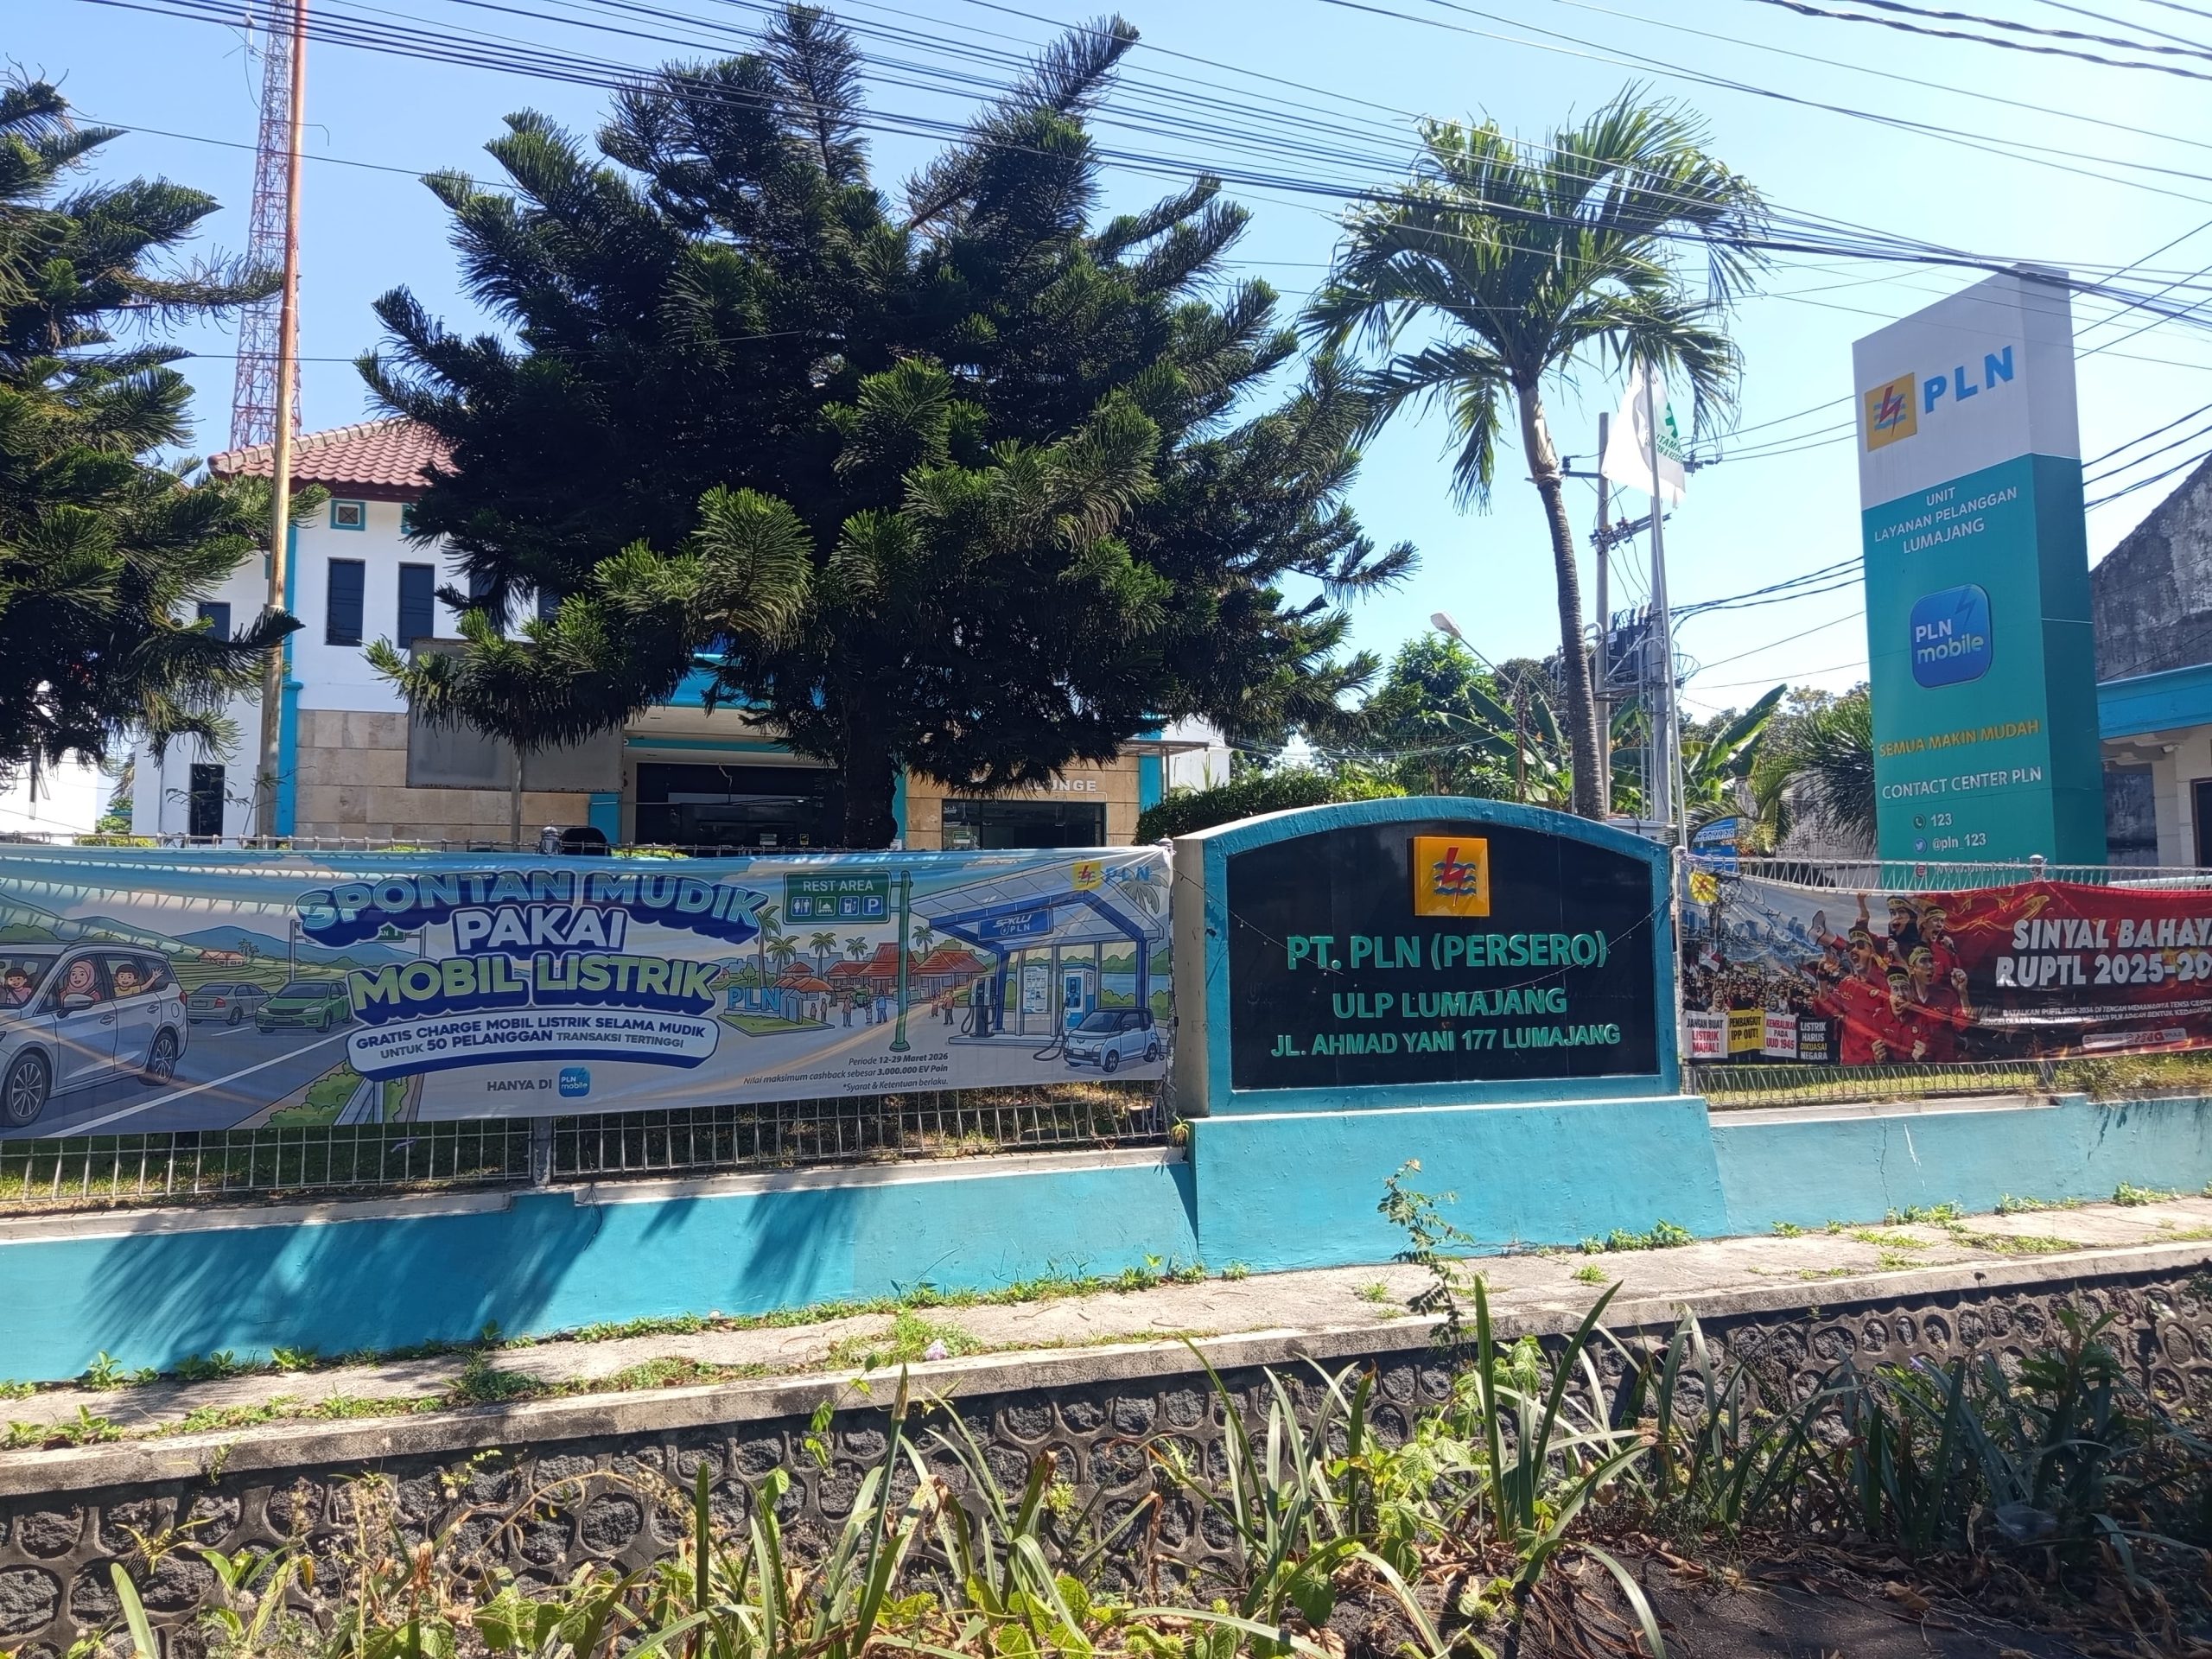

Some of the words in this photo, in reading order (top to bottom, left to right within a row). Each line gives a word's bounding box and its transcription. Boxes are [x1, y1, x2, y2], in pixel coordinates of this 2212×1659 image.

[1923, 345, 2014, 415] PLN
[1926, 486, 1956, 507] UNIT
[1874, 514, 1933, 543] LAYANAN
[1935, 486, 2018, 524] PELANGGAN
[1903, 517, 1985, 554] LUMAJANG
[1915, 618, 1953, 643] PLN
[1916, 632, 1985, 664] mobile
[1878, 739, 1926, 758] SEMUA
[1928, 729, 1977, 750] MAKIN
[1980, 719, 2040, 741] MUDAH
[1882, 779, 1948, 799] CONTACT
[1951, 771, 2008, 791] CENTER
[2012, 766, 2043, 783] PLN
[1930, 813, 1953, 827] 123
[1932, 832, 1986, 851] @pln_123
[803, 880, 836, 893] REST
[839, 880, 874, 892] AREA
[297, 872, 570, 931] SPONTAN
[589, 873, 769, 928] MUDIK
[868, 899, 879, 913] P
[455, 907, 625, 950] PAKAI
[1010, 923, 1031, 933] PLN
[2012, 918, 2109, 949] SINYAL
[2117, 918, 2212, 947] BAHAY
[1286, 935, 1342, 970] PT.
[1350, 935, 1421, 969] PLN
[1431, 930, 1608, 971] (PERSERO)
[1995, 955, 2086, 987] RUPTL
[348, 956, 524, 1011] MOBIL
[537, 954, 721, 1001] LISTRIK
[728, 987, 779, 1012] PLN
[1332, 992, 1395, 1019] ULP
[1401, 987, 1567, 1018] LUMAJANG
[1687, 1018, 1707, 1028] JANGAN
[1708, 1019, 1724, 1028] BUAT
[1729, 1016, 1761, 1028] PEMBANGKIT
[1800, 1021, 1827, 1032] LISTRIK
[356, 1029, 412, 1050] GRATIS
[416, 1020, 481, 1039] CHARGE
[486, 1017, 534, 1031] MOBIL
[537, 1017, 591, 1028] LISTRIK
[595, 1018, 655, 1032] SELAMA
[658, 1021, 706, 1038] MUDIK
[1270, 1033, 1307, 1058] JL.
[1311, 1033, 1398, 1056] AHMAD
[1405, 1030, 1455, 1052] YANI
[1461, 1028, 1497, 1051] 177
[1502, 1023, 1621, 1049] LUMAJANG
[1692, 1030, 1719, 1041] LISTRIK
[1743, 1028, 1758, 1039] OUT!
[1766, 1038, 1779, 1047] UUD
[1780, 1039, 1795, 1050] 1945
[1802, 1033, 1825, 1042] HARUS
[380, 1044, 424, 1059] UNTUK
[427, 1038, 448, 1051] 50
[453, 1030, 553, 1048] PELANGGAN
[556, 1032, 621, 1043] TRANSAKSI
[625, 1033, 684, 1048] TERTINGGI
[1692, 1042, 1719, 1053] MAHAL!
[1800, 1042, 1827, 1051] DIKUASAI
[848, 1057, 877, 1066] Periode
[878, 1055, 901, 1064] 12-29
[903, 1053, 927, 1063] Maret
[928, 1052, 949, 1061] 2026
[1800, 1051, 1828, 1060] NEGARA
[487, 1079, 535, 1091] HANYA
[538, 1079, 552, 1090] DI
[743, 1076, 763, 1085] Nilai
[763, 1072, 808, 1084] maksimum
[809, 1071, 846, 1080] cashback
[847, 1068, 876, 1077] sebesar
[877, 1066, 917, 1076] 3.000.000
[918, 1065, 929, 1073] EV
[931, 1064, 948, 1073] Poin
[879, 1079, 918, 1089] Ketentuan
[918, 1077, 949, 1087] berlaku.
[561, 1081, 588, 1090] mobile
